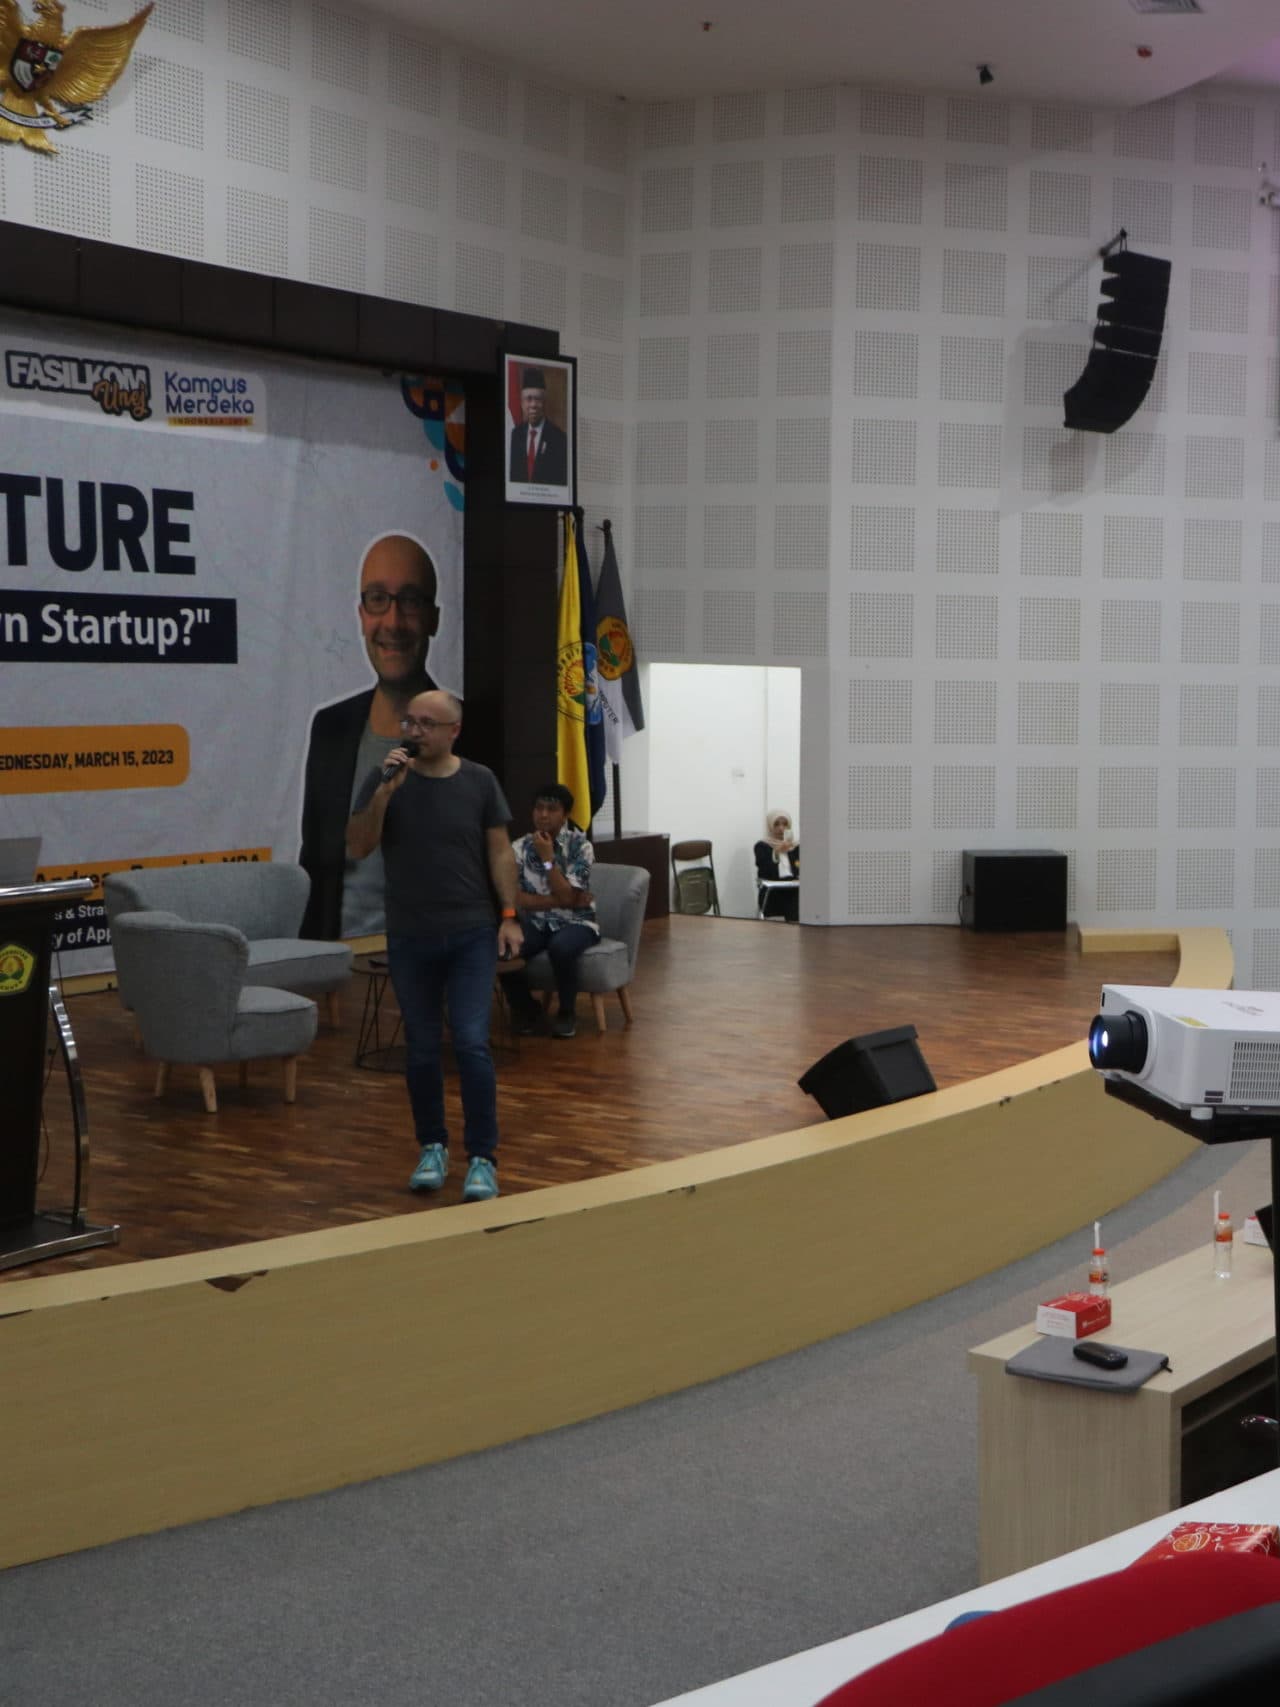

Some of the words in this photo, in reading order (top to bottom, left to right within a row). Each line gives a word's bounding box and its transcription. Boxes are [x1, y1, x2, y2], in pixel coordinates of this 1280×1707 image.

[8, 353, 147, 391] FASILKOM
[164, 371, 247, 399] Kampus
[93, 379, 152, 419] Unej
[165, 394, 254, 414] Merdeka
[41, 604, 210, 655] Startup?"
[75, 751, 119, 768] MARCH
[122, 751, 139, 767] 15,
[142, 750, 173, 765] 2023
[78, 904, 106, 918] Stra
[67, 928, 82, 944] of
